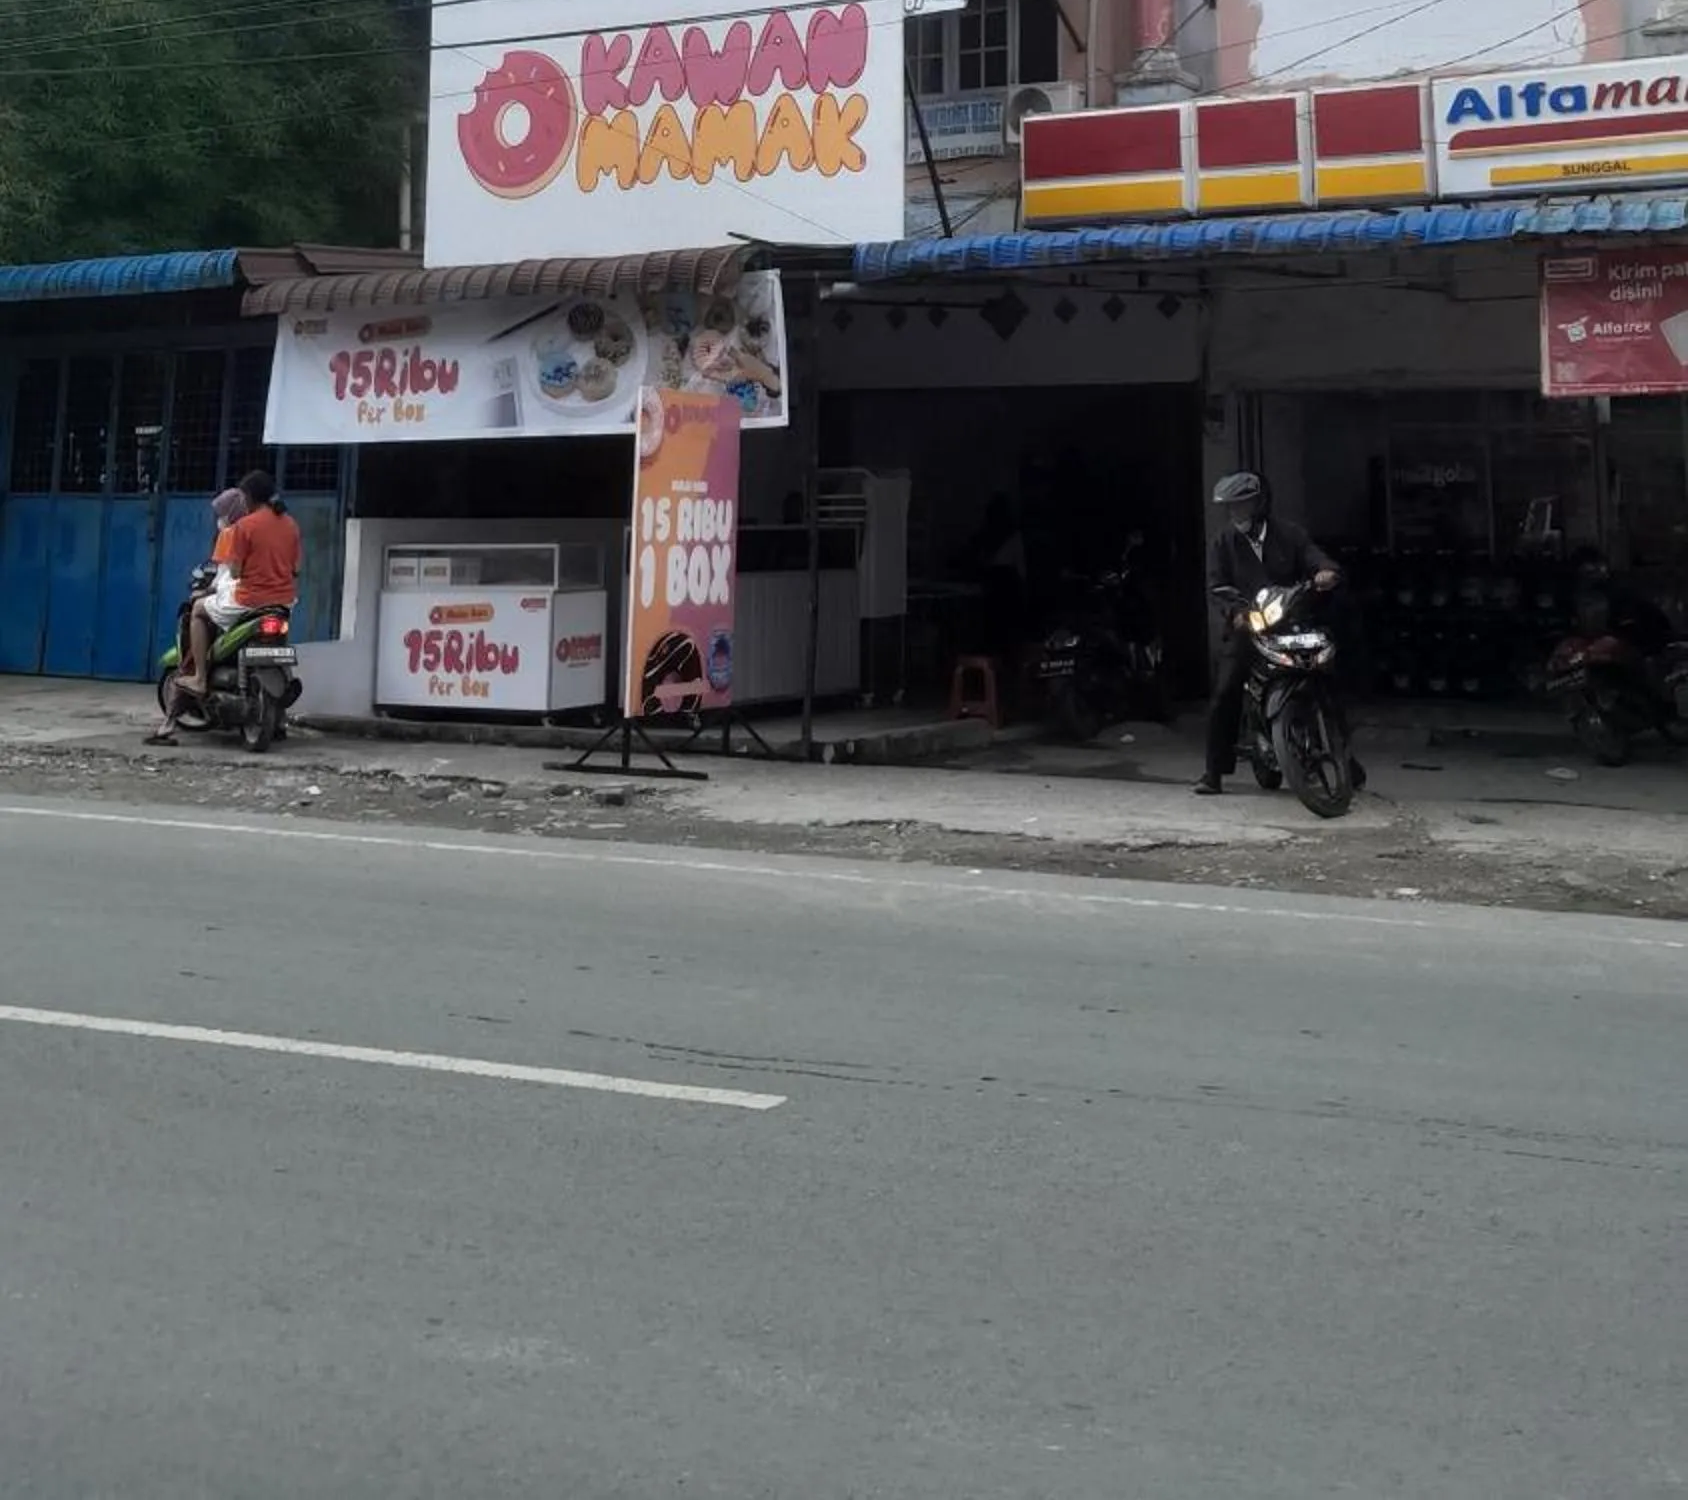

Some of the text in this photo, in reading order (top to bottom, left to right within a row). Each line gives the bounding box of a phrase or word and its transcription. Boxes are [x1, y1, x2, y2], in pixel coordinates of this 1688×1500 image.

[581, 2, 868, 116] KAWAN
[1446, 75, 1688, 125] Alfama
[576, 93, 868, 193] MAMAK
[1561, 160, 1632, 176] SUNGGAL
[1608, 261, 1657, 281] Kirim
[357, 399, 426, 424] Per Box
[641, 496, 733, 542] 15 RIBU
[640, 543, 731, 609] 1 BOX
[429, 675, 490, 697] Per Box
